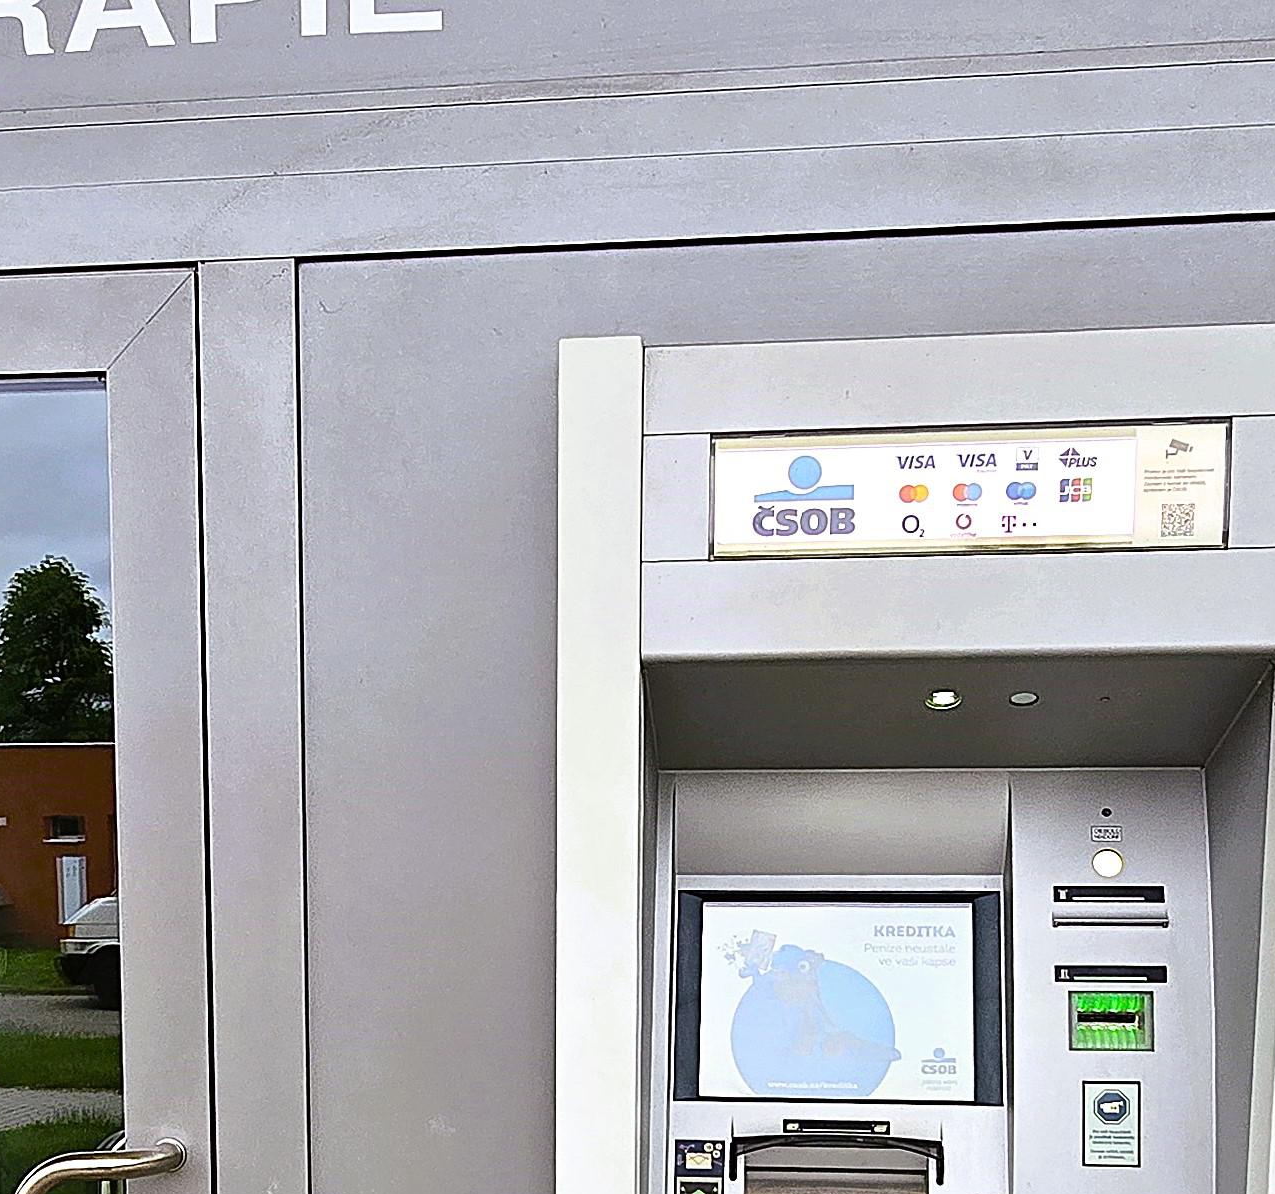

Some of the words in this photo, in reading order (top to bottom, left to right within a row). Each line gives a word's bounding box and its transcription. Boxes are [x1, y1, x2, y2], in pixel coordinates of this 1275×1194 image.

[897, 456, 935, 469] VISA
[957, 454, 997, 467] VISA
[1068, 456, 1097, 467] PLUS
[1059, 478, 1093, 502] JCB
[752, 505, 855, 537] ČSOB
[873, 925, 956, 938] KREDITKA
